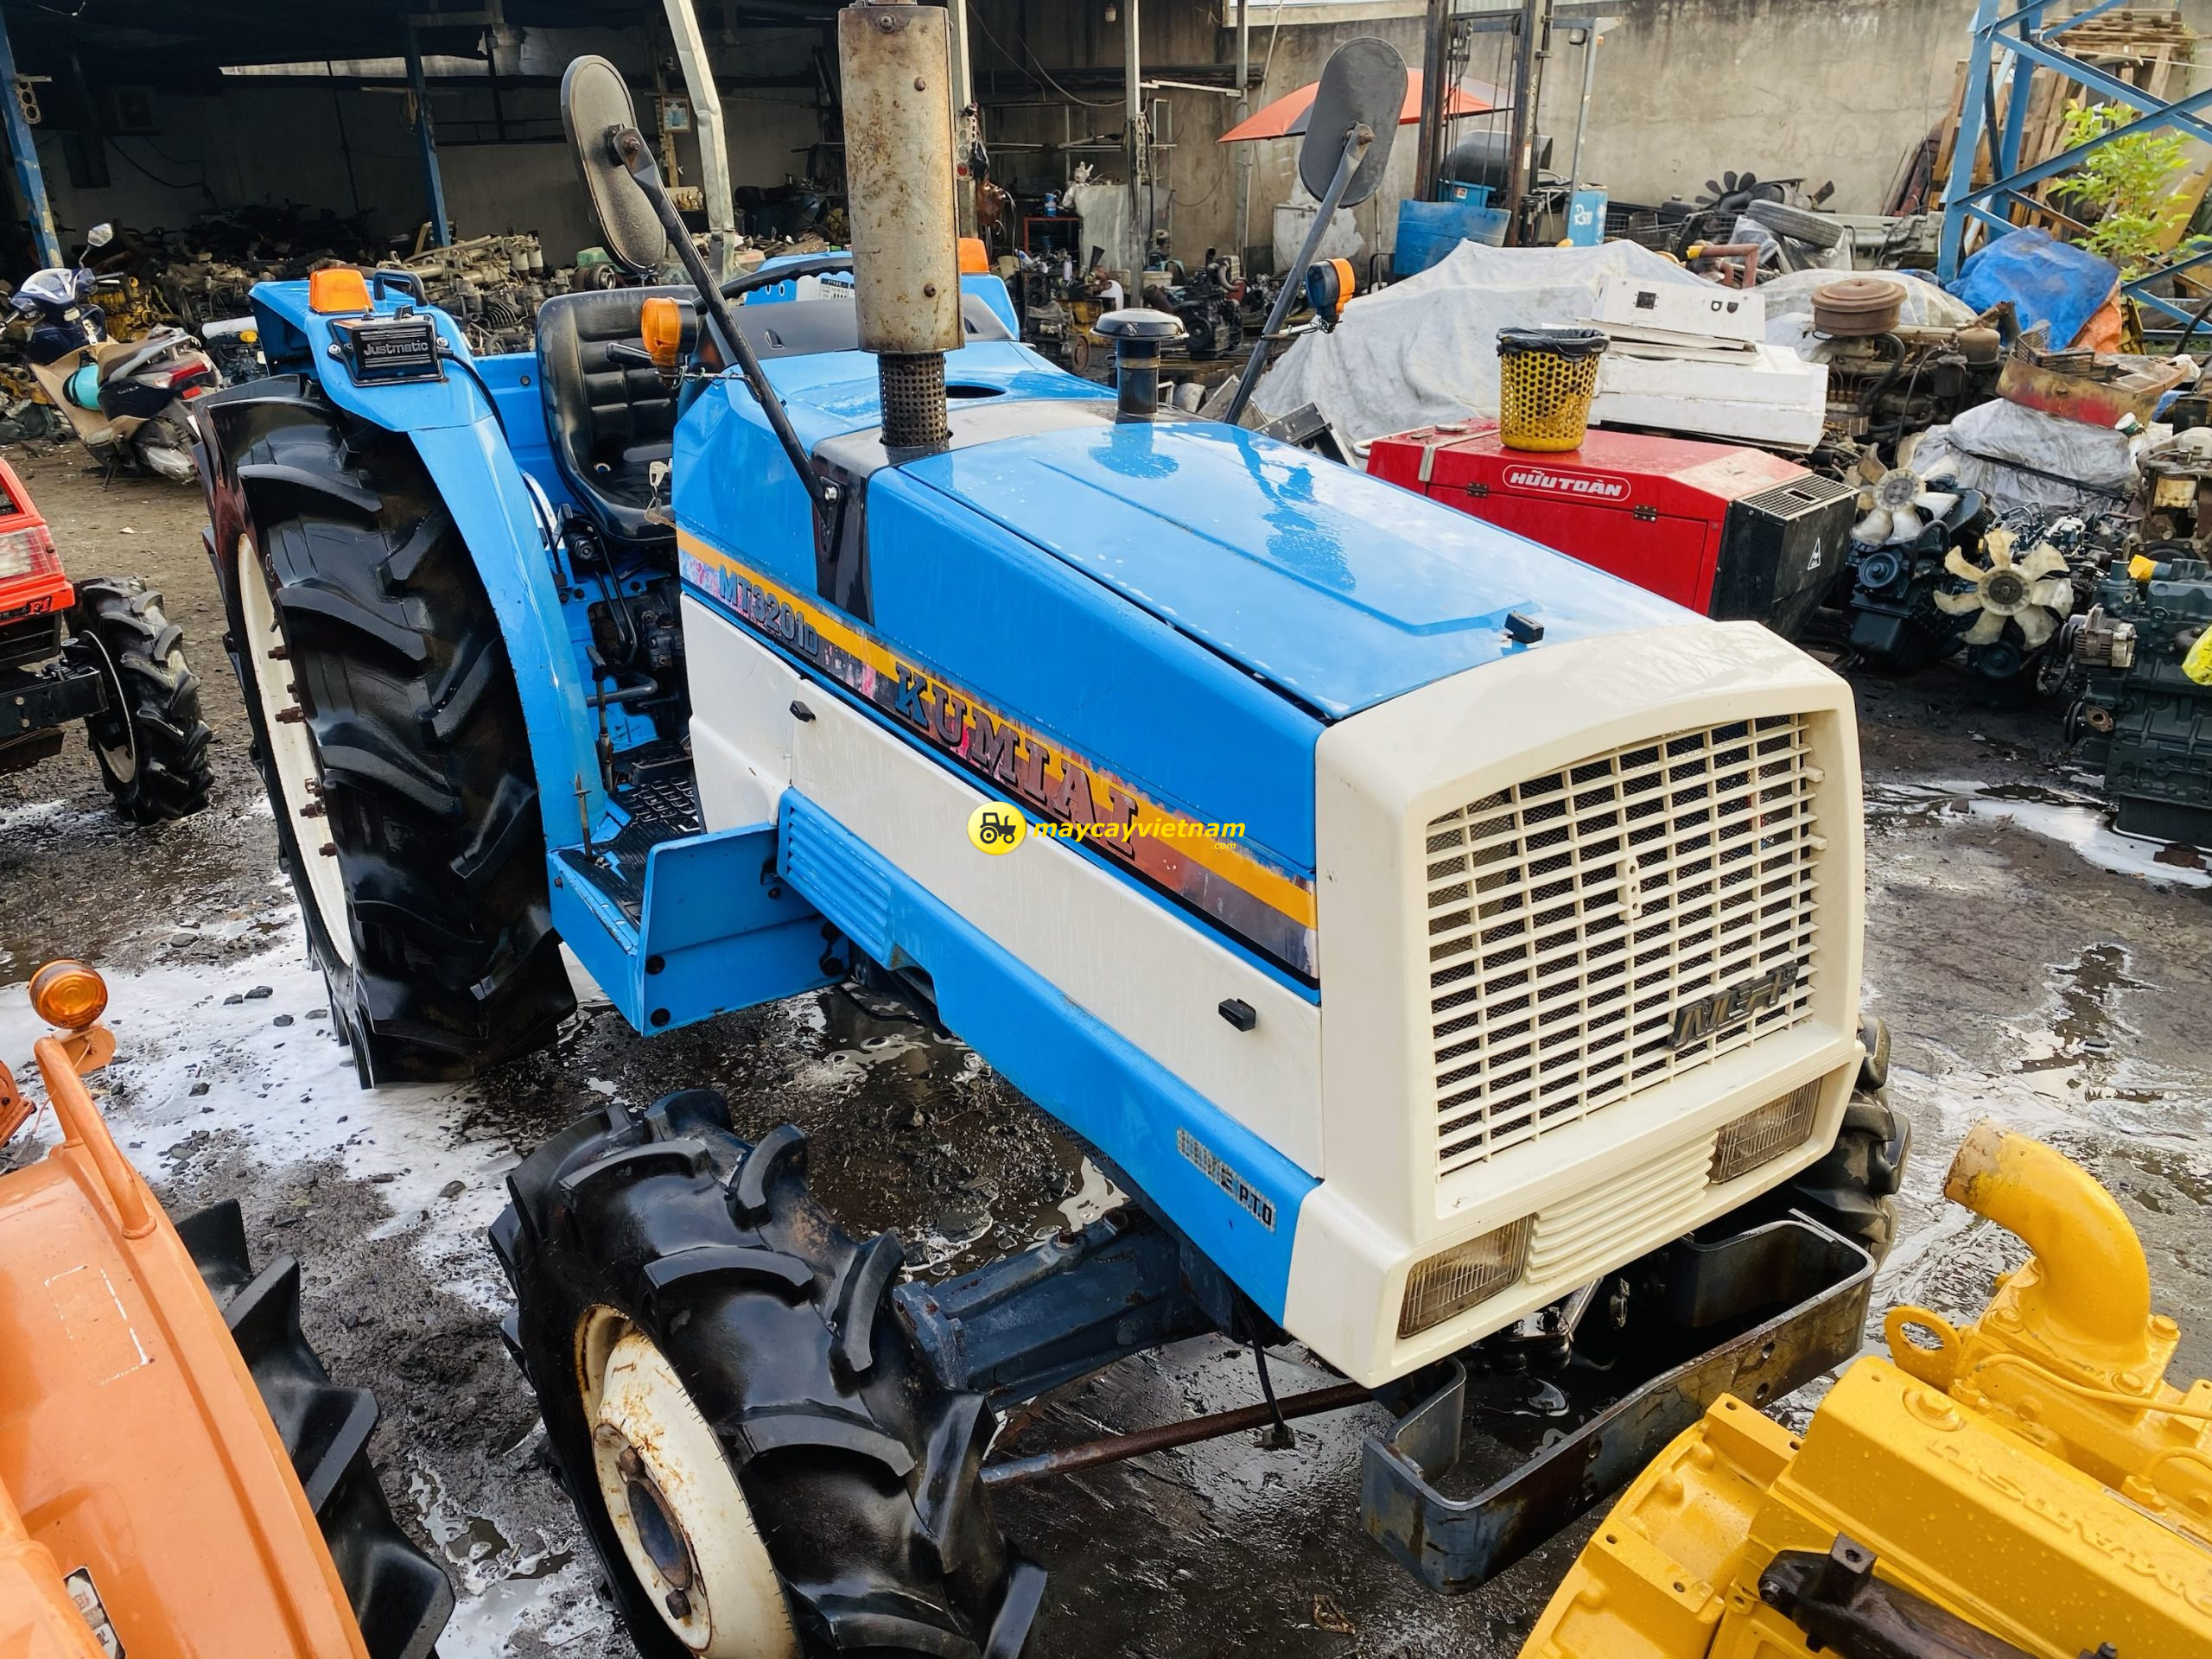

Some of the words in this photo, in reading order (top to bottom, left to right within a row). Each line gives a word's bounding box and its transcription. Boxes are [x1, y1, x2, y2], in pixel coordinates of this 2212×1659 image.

[364, 340, 429, 356] Justmatic
[719, 563, 819, 657] MT3201D
[895, 660, 1139, 862] KUMIAI
